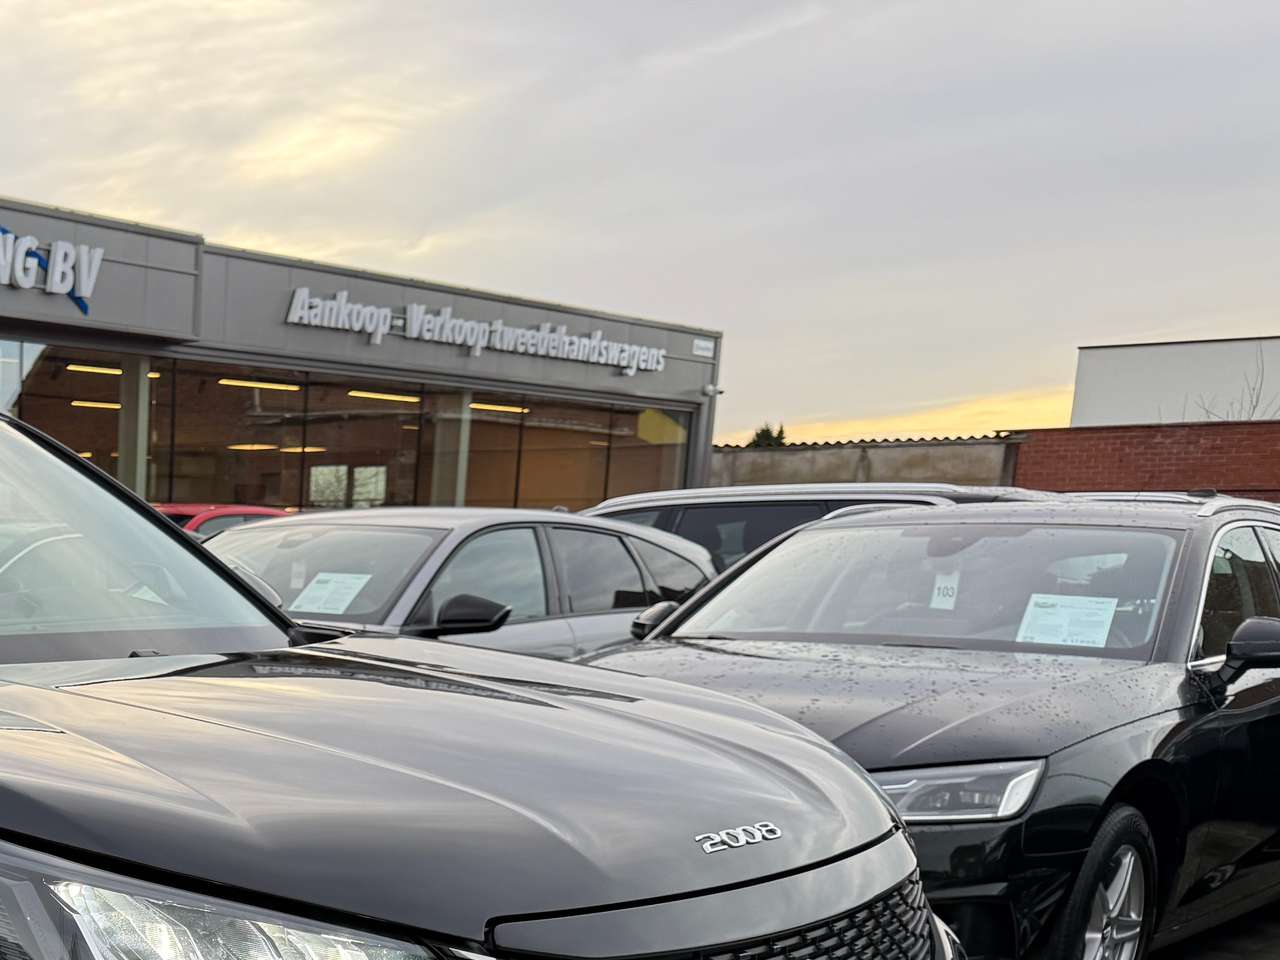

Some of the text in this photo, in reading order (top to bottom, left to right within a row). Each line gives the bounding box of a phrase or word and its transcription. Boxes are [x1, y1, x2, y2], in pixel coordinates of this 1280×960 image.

[46, 240, 104, 298] BV
[287, 288, 391, 345] Aankoop
[406, 303, 490, 357] Verkoop
[491, 320, 667, 376] tweedehandswagens
[695, 821, 782, 854] 2008
